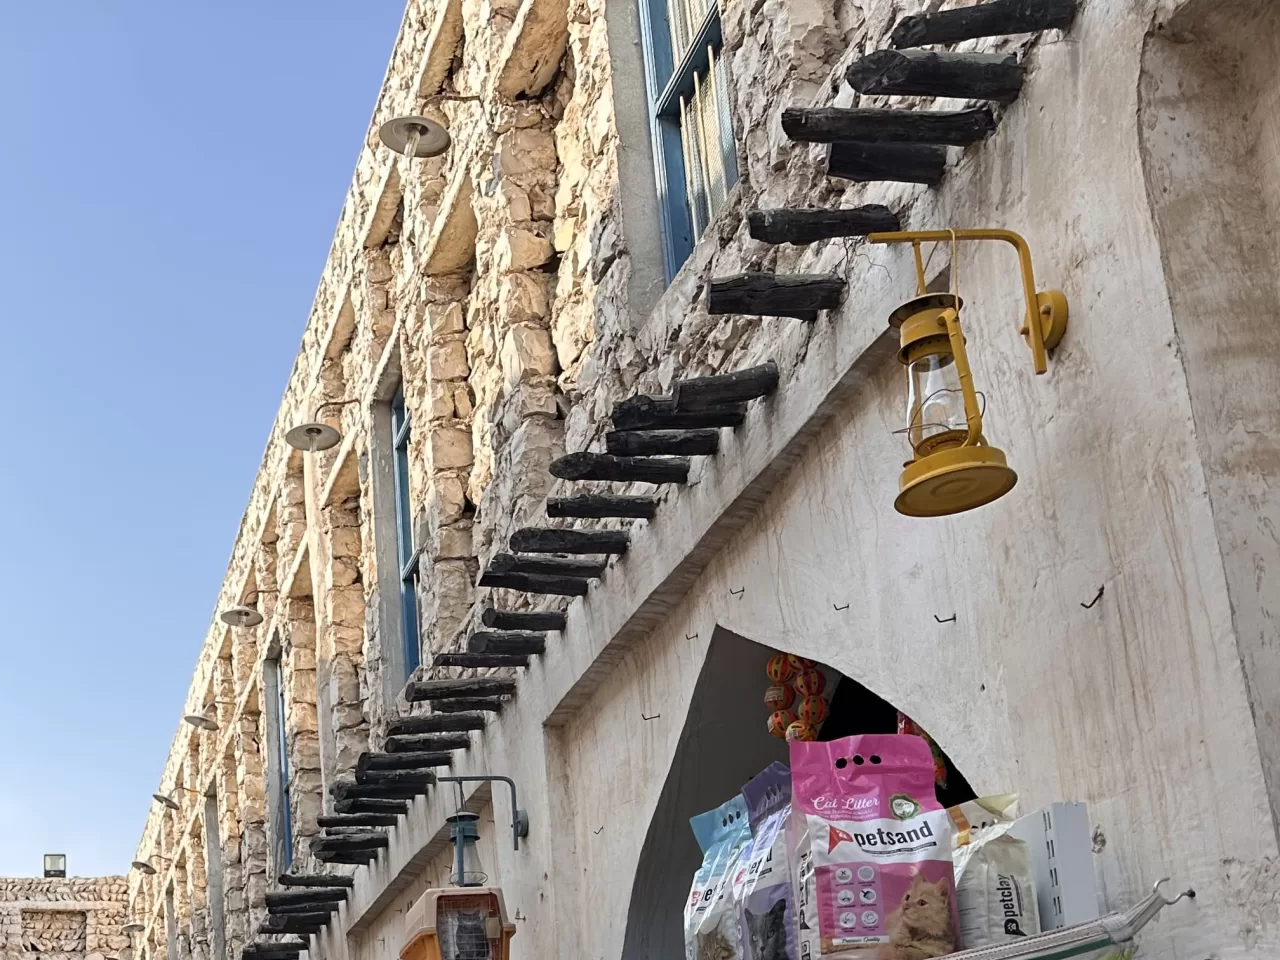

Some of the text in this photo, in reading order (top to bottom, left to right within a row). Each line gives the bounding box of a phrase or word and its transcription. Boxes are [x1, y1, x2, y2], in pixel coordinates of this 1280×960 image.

[811, 796, 838, 810] Cat
[841, 797, 880, 811] Litter
[854, 820, 933, 847] petsand
[997, 874, 1019, 918] petclay
